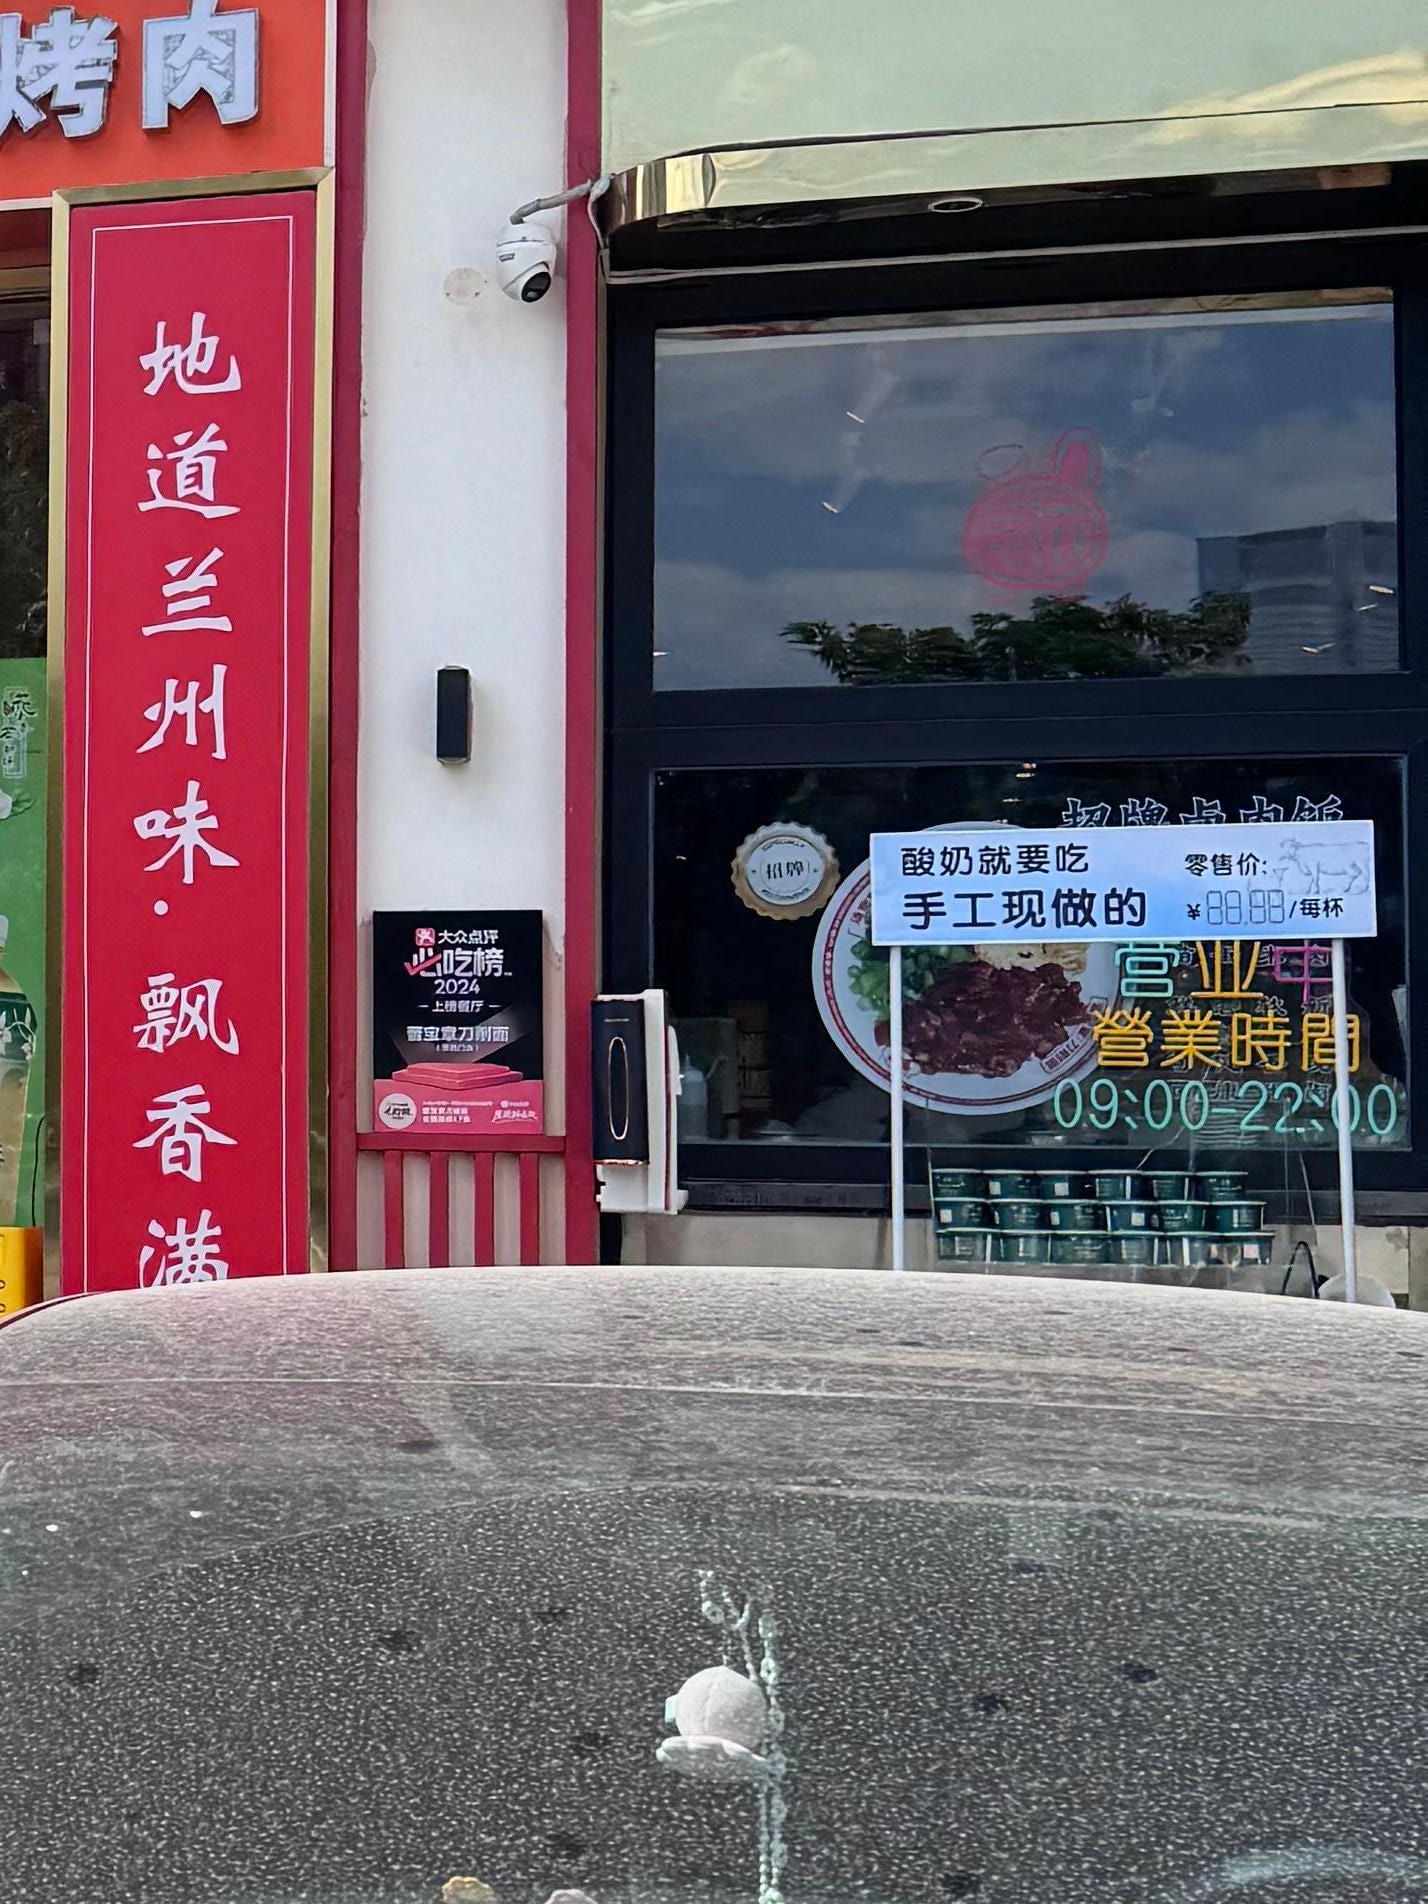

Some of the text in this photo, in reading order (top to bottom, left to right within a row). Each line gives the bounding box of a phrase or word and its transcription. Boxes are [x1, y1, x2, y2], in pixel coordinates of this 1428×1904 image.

[900, 843, 1090, 878] 酸奶就要吃
[902, 886, 1147, 930] 手工现做的
[437, 929, 499, 945] 大众点评
[403, 947, 505, 977] 必吃榜
[434, 978, 480, 995] 2024
[1092, 1007, 1360, 1074] 營業時間
